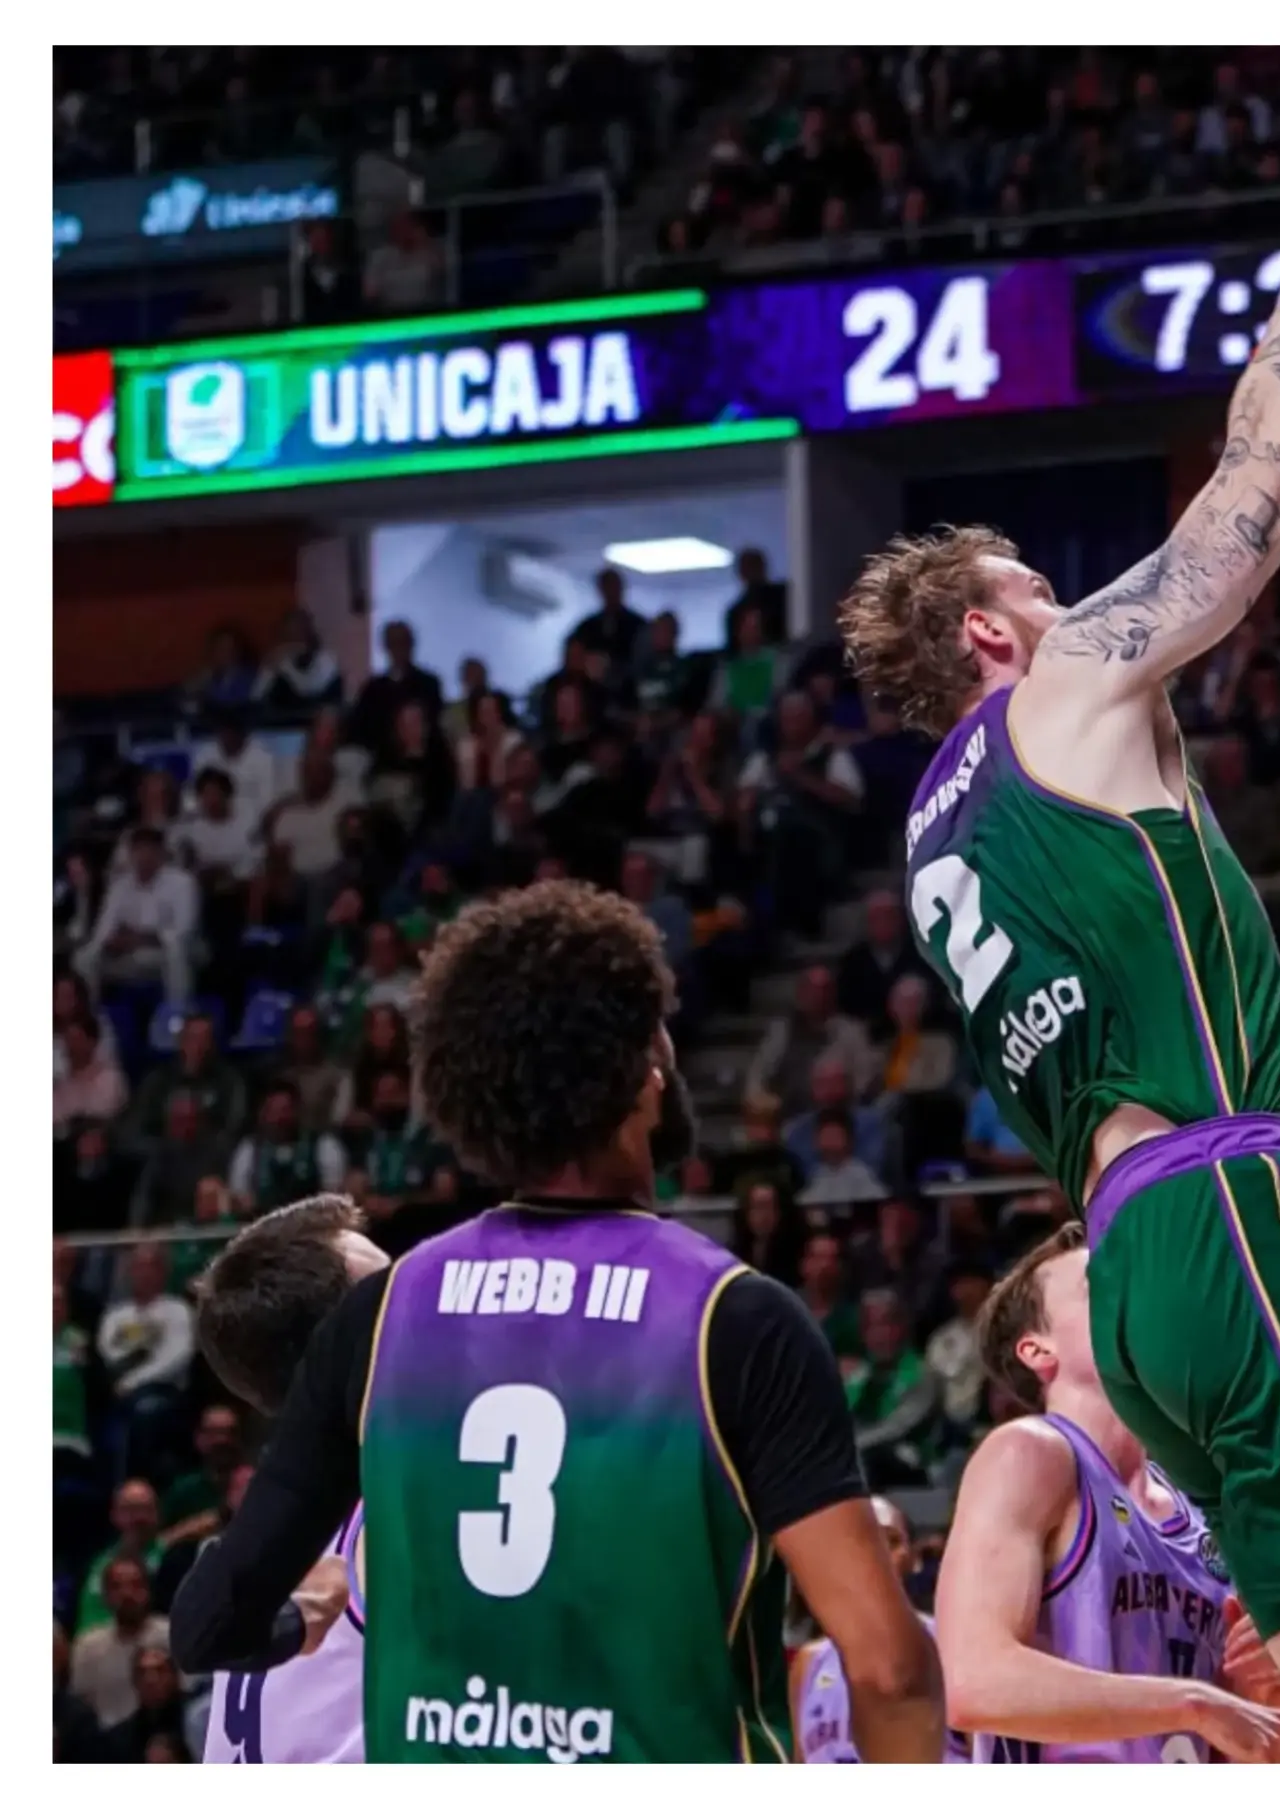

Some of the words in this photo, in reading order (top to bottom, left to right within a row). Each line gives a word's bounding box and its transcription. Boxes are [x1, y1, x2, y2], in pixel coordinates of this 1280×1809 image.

[310, 332, 640, 448] UNICAJA
[842, 275, 1000, 412] 24
[438, 1257, 577, 1315] WEBB
[584, 1263, 650, 1322] III
[457, 1383, 567, 1598] 3
[1112, 1573, 1169, 1616] ALBA
